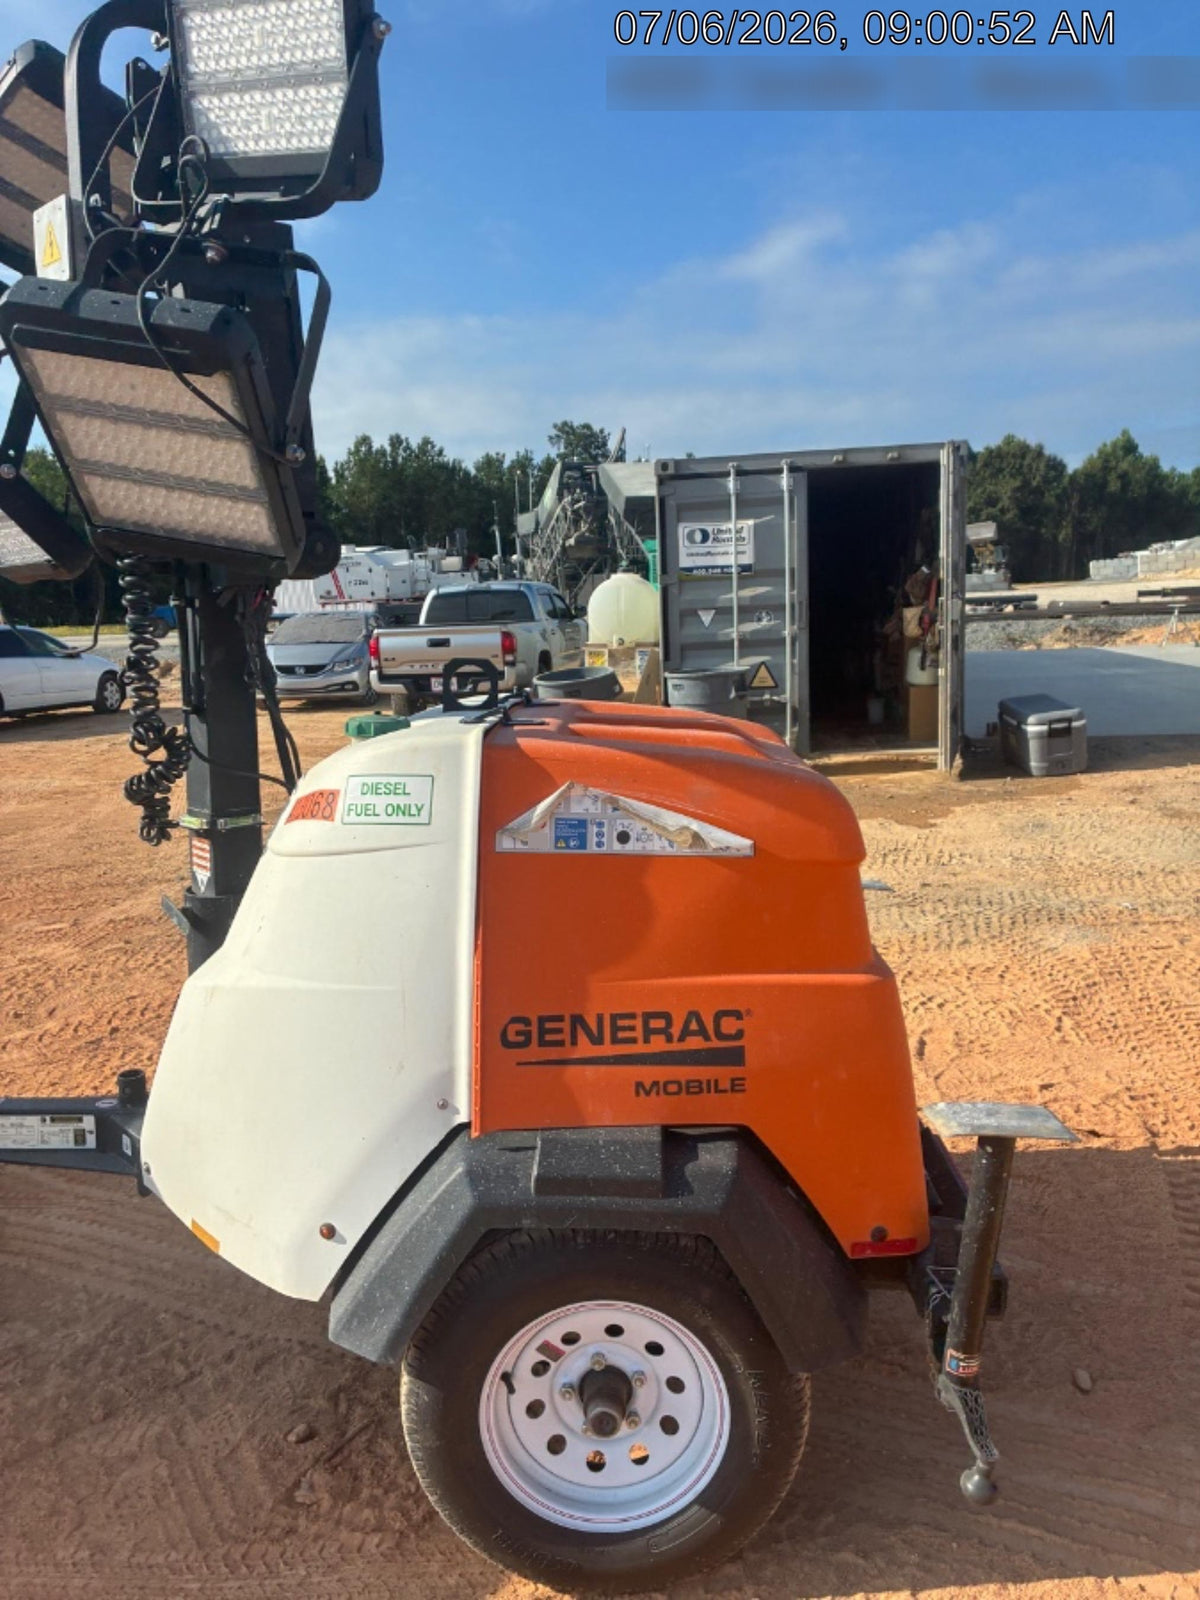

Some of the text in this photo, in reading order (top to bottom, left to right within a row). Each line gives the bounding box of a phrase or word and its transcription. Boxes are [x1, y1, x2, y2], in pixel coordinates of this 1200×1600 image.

[360, 781, 411, 796] DIESEL
[346, 802, 425, 817] FUEL ONLY
[500, 1008, 746, 1050] GENERAC
[634, 1077, 746, 1098] MOBILE
